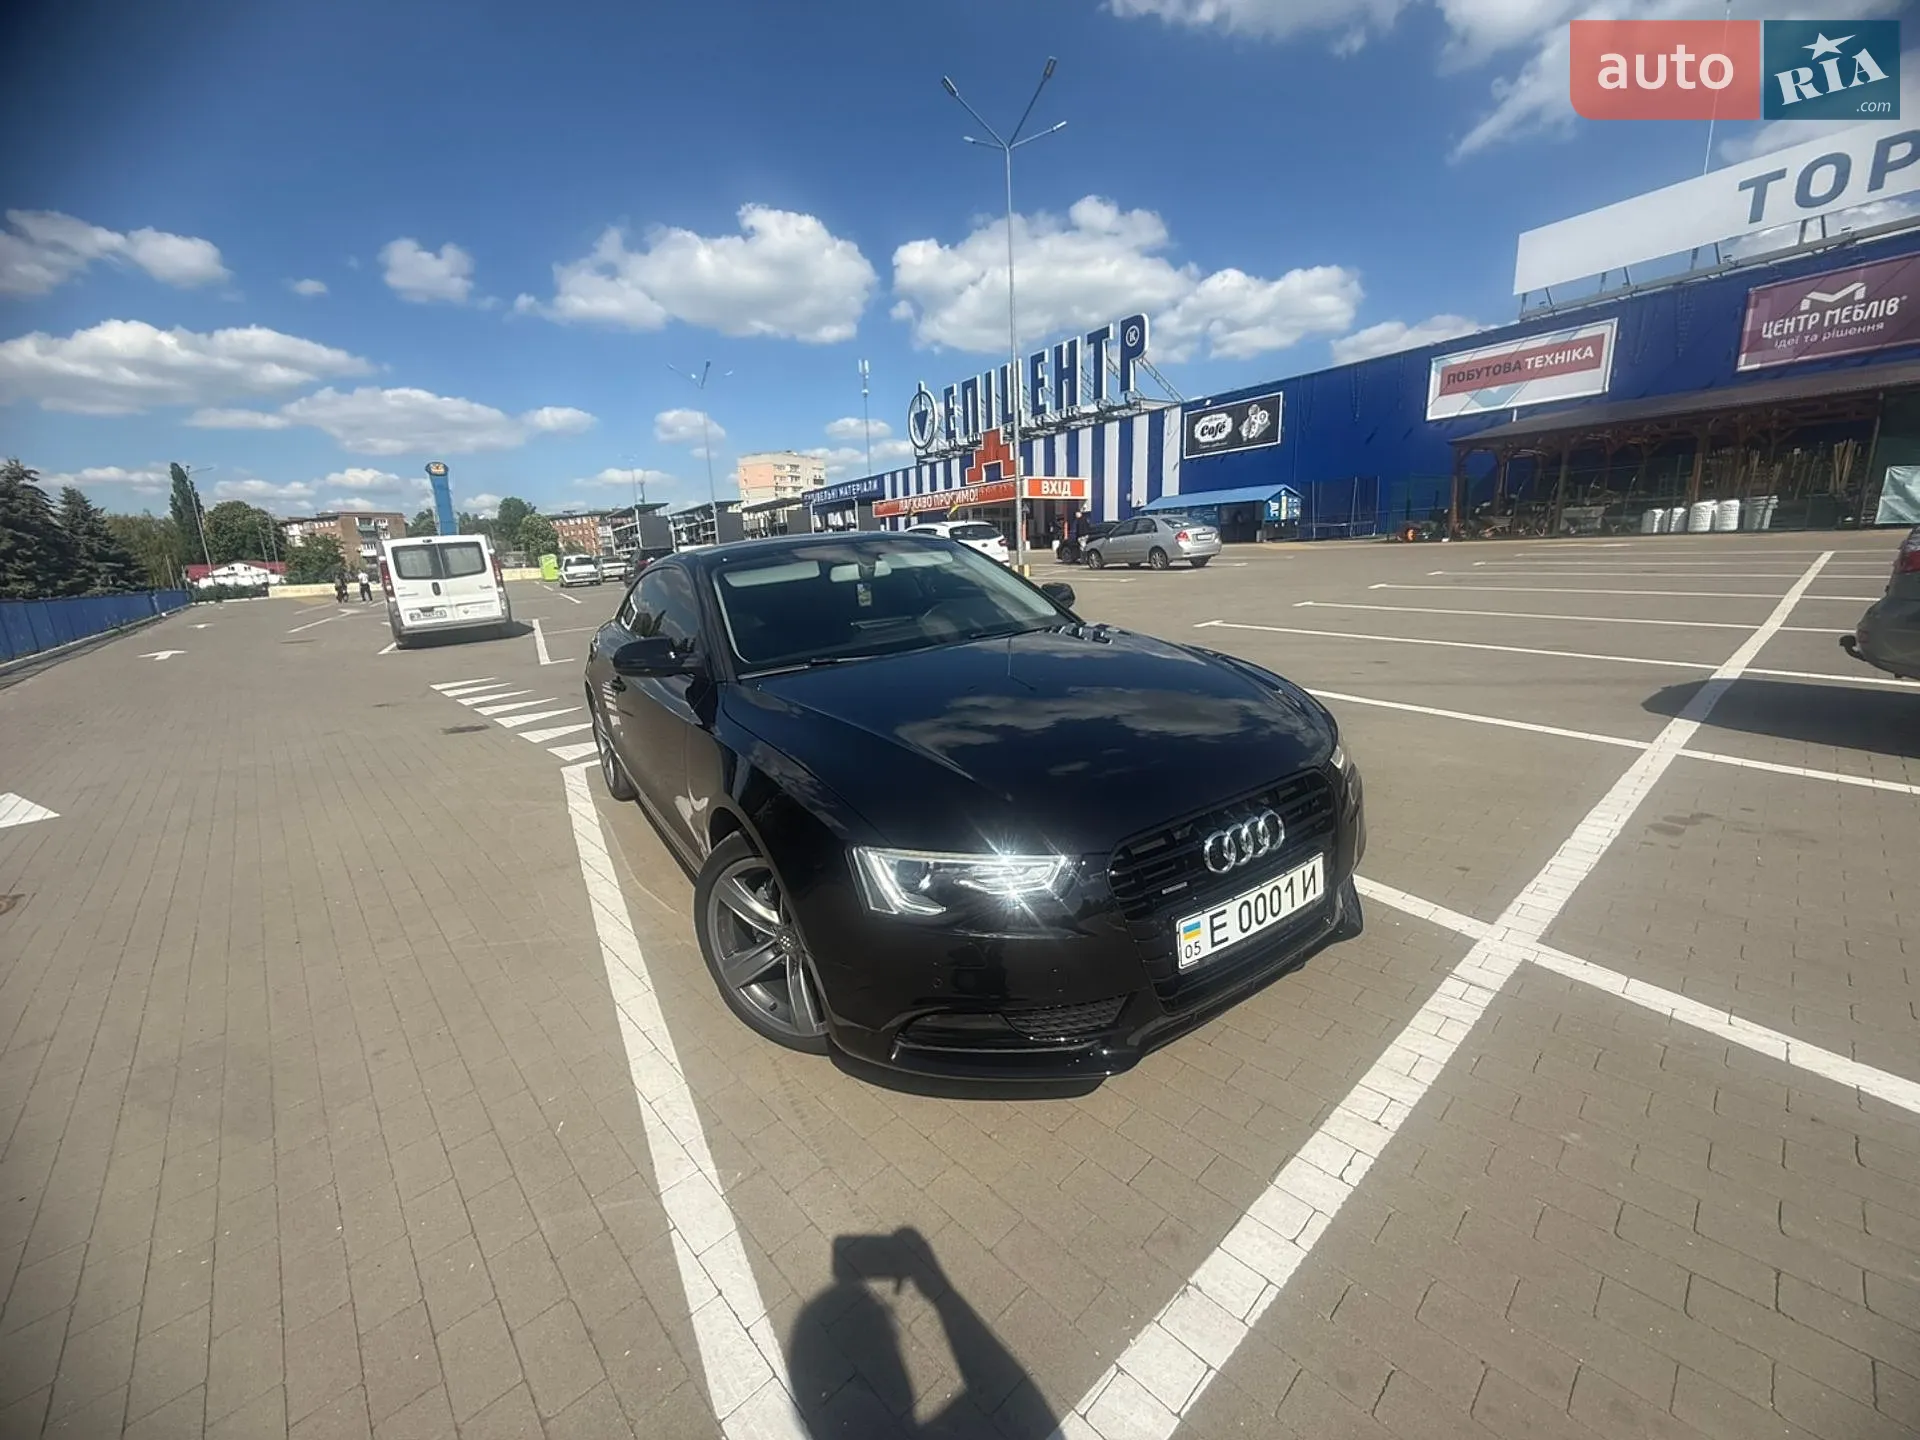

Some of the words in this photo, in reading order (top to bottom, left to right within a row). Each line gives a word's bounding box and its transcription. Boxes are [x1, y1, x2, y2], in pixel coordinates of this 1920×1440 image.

[1761, 312, 1820, 339] ЦЕНТР
[1774, 335, 1799, 350] ідеї
[1803, 333, 1818, 343] та
[1821, 322, 1885, 343] рішення
[943, 313, 1149, 442] ЕПІЦЕНТР
[1447, 359, 1522, 385] ПОБУТОВА
[1524, 345, 1594, 370] ТЕХНІКА
[1200, 421, 1226, 438] Café
[1041, 480, 1071, 496] ВХІД
[1185, 940, 1201, 959] 05
